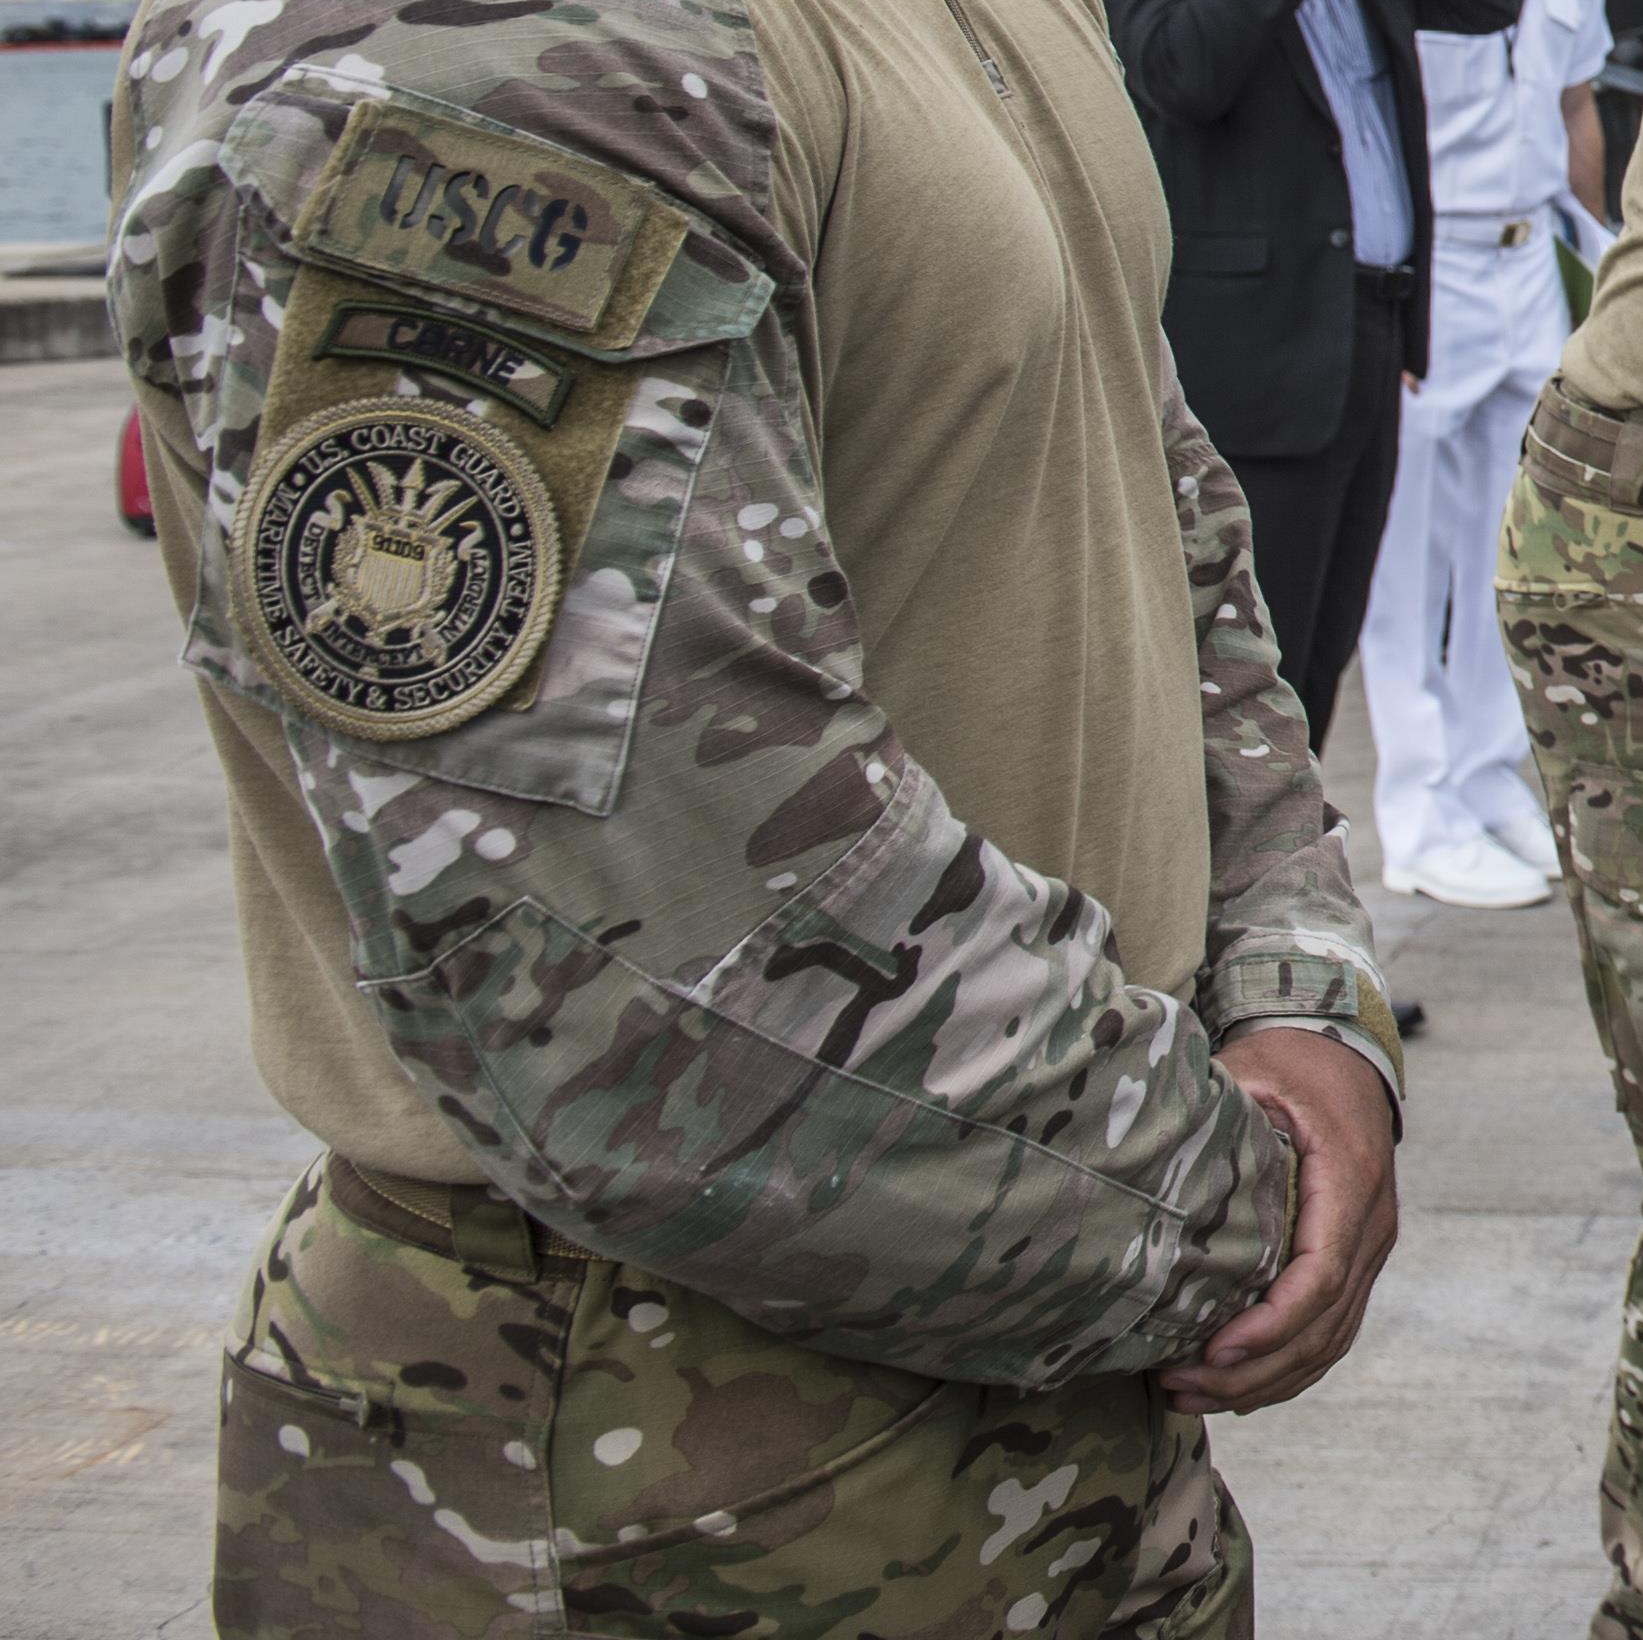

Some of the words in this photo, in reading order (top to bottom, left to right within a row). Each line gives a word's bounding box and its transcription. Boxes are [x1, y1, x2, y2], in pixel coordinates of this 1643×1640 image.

[379, 154, 588, 271] USCG
[386, 316, 526, 388] CBRNE
[300, 439, 348, 473] U.S.
[351, 424, 446, 454] COAST
[451, 442, 521, 519] GUARD
[257, 482, 302, 623] MARITIME
[300, 522, 326, 601] DETECT
[372, 533, 426, 560] 91109
[501, 539, 533, 619] TEAM
[439, 549, 489, 644] INTERDICT
[276, 624, 362, 703] SAFETY
[366, 686, 386, 709] &
[393, 620, 513, 711] SECURITY
